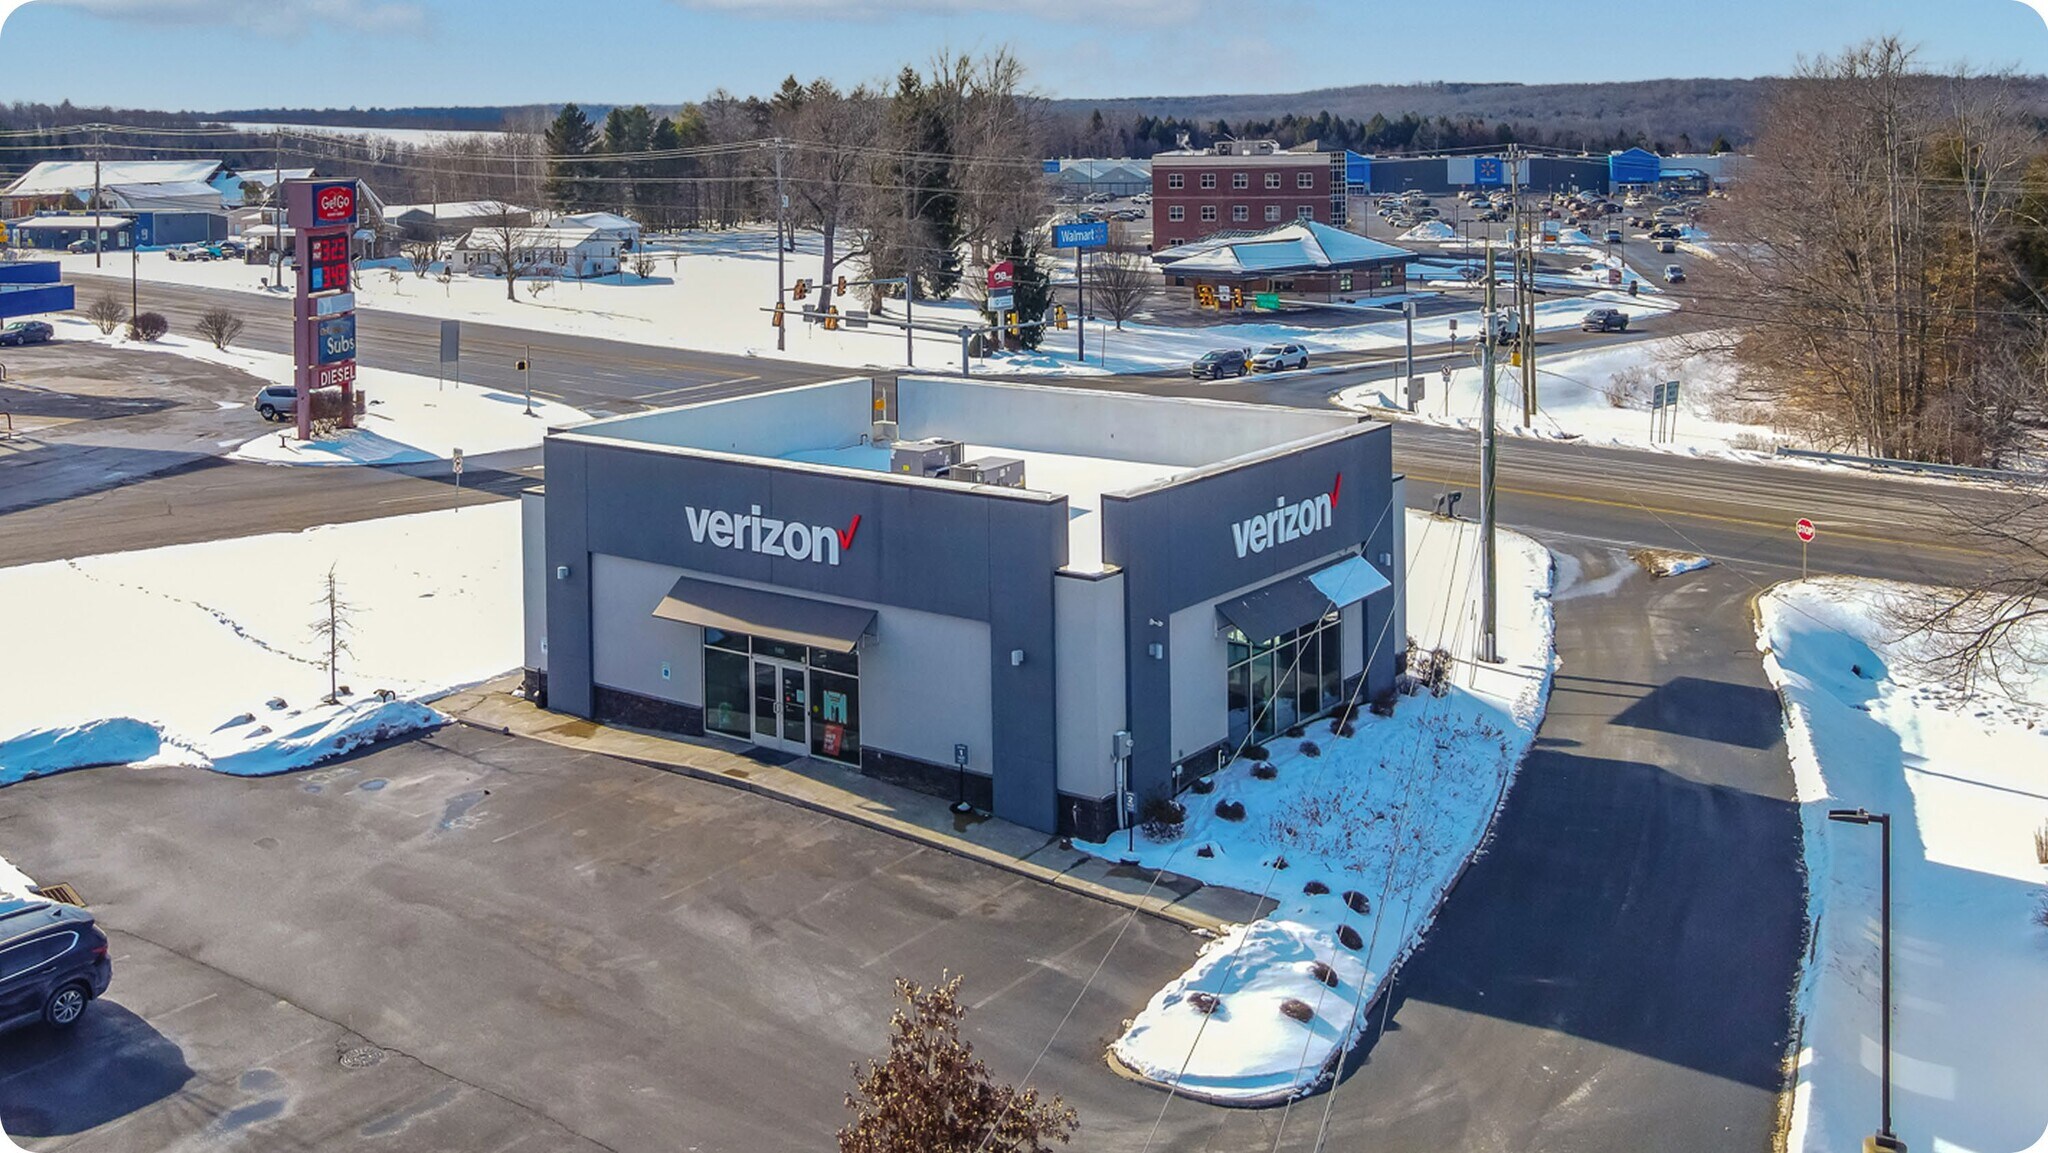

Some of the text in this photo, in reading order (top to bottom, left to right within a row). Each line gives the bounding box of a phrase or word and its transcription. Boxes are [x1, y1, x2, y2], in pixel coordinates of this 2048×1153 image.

[321, 195, 350, 210] GetGo
[1061, 229, 1094, 243] Walmart
[327, 335, 355, 355] Subs
[320, 365, 355, 386] DIESEL
[685, 504, 840, 566] verizon
[1231, 493, 1332, 558] verizon
[1797, 524, 1813, 536] STOP
